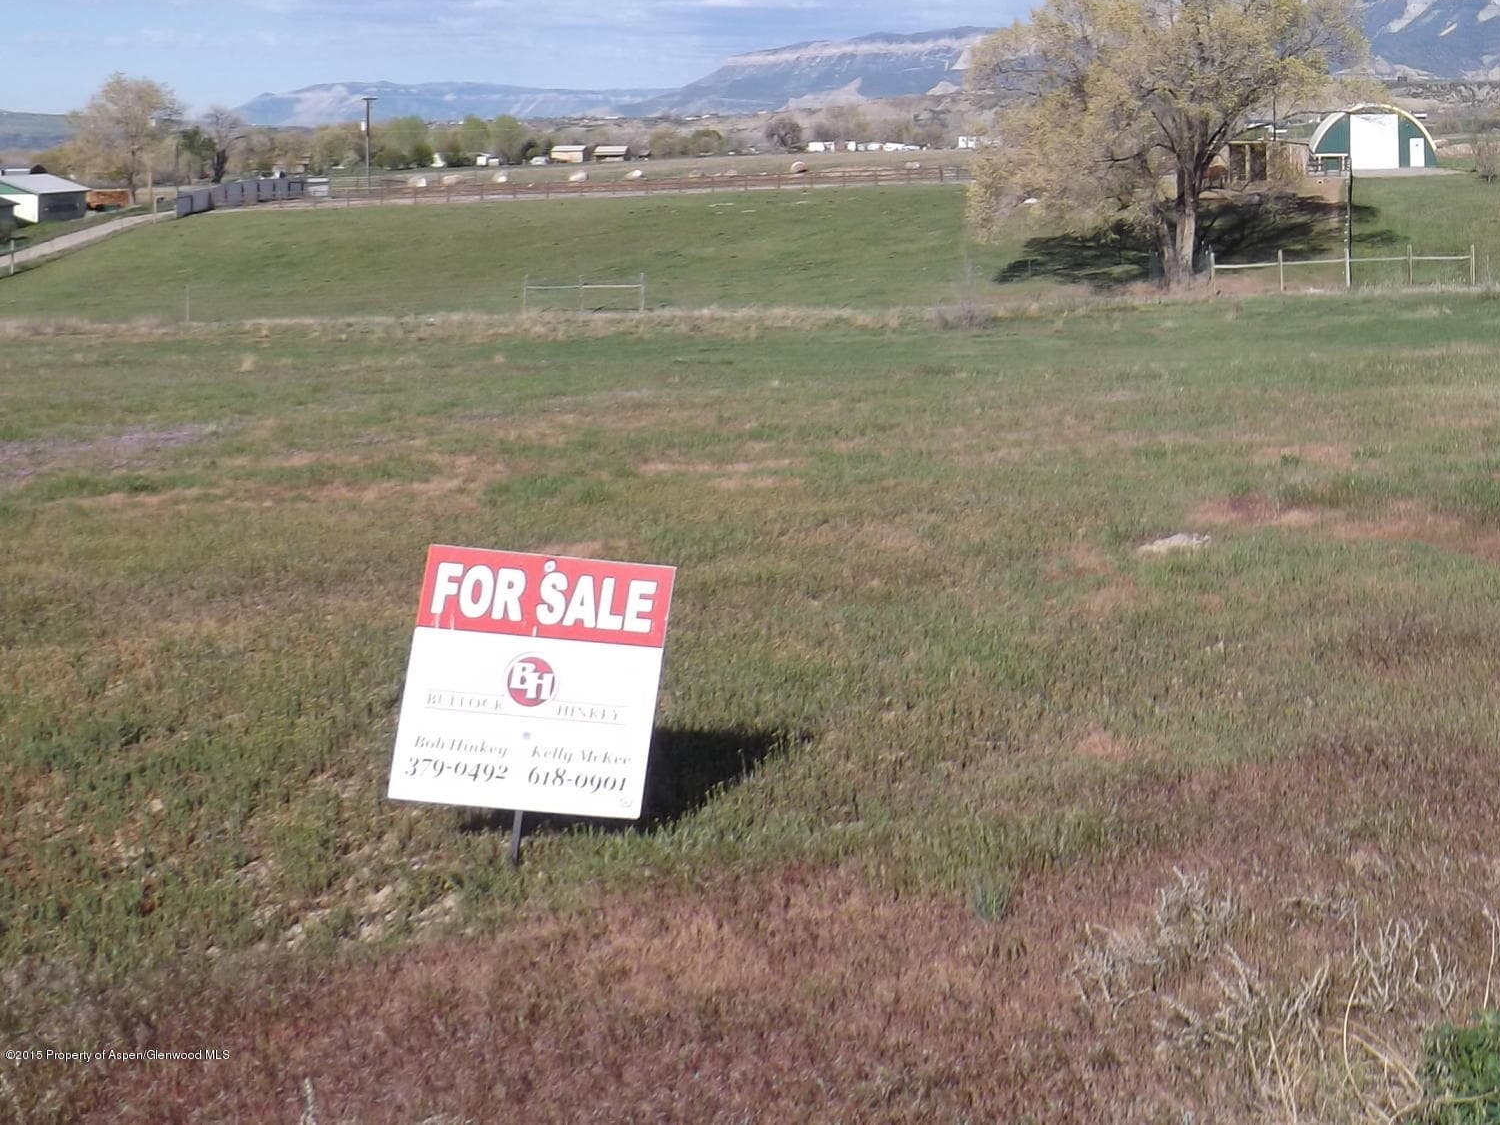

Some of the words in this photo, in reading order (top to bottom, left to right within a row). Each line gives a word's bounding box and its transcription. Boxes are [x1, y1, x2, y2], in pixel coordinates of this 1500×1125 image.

[430, 562, 527, 622] FOR
[535, 568, 658, 633] SALE
[414, 735, 446, 751] Bob
[449, 738, 509, 757] Hinkey
[531, 745, 574, 764] Kelly
[405, 757, 509, 783] 379-0492
[528, 766, 627, 793] 618-0901
